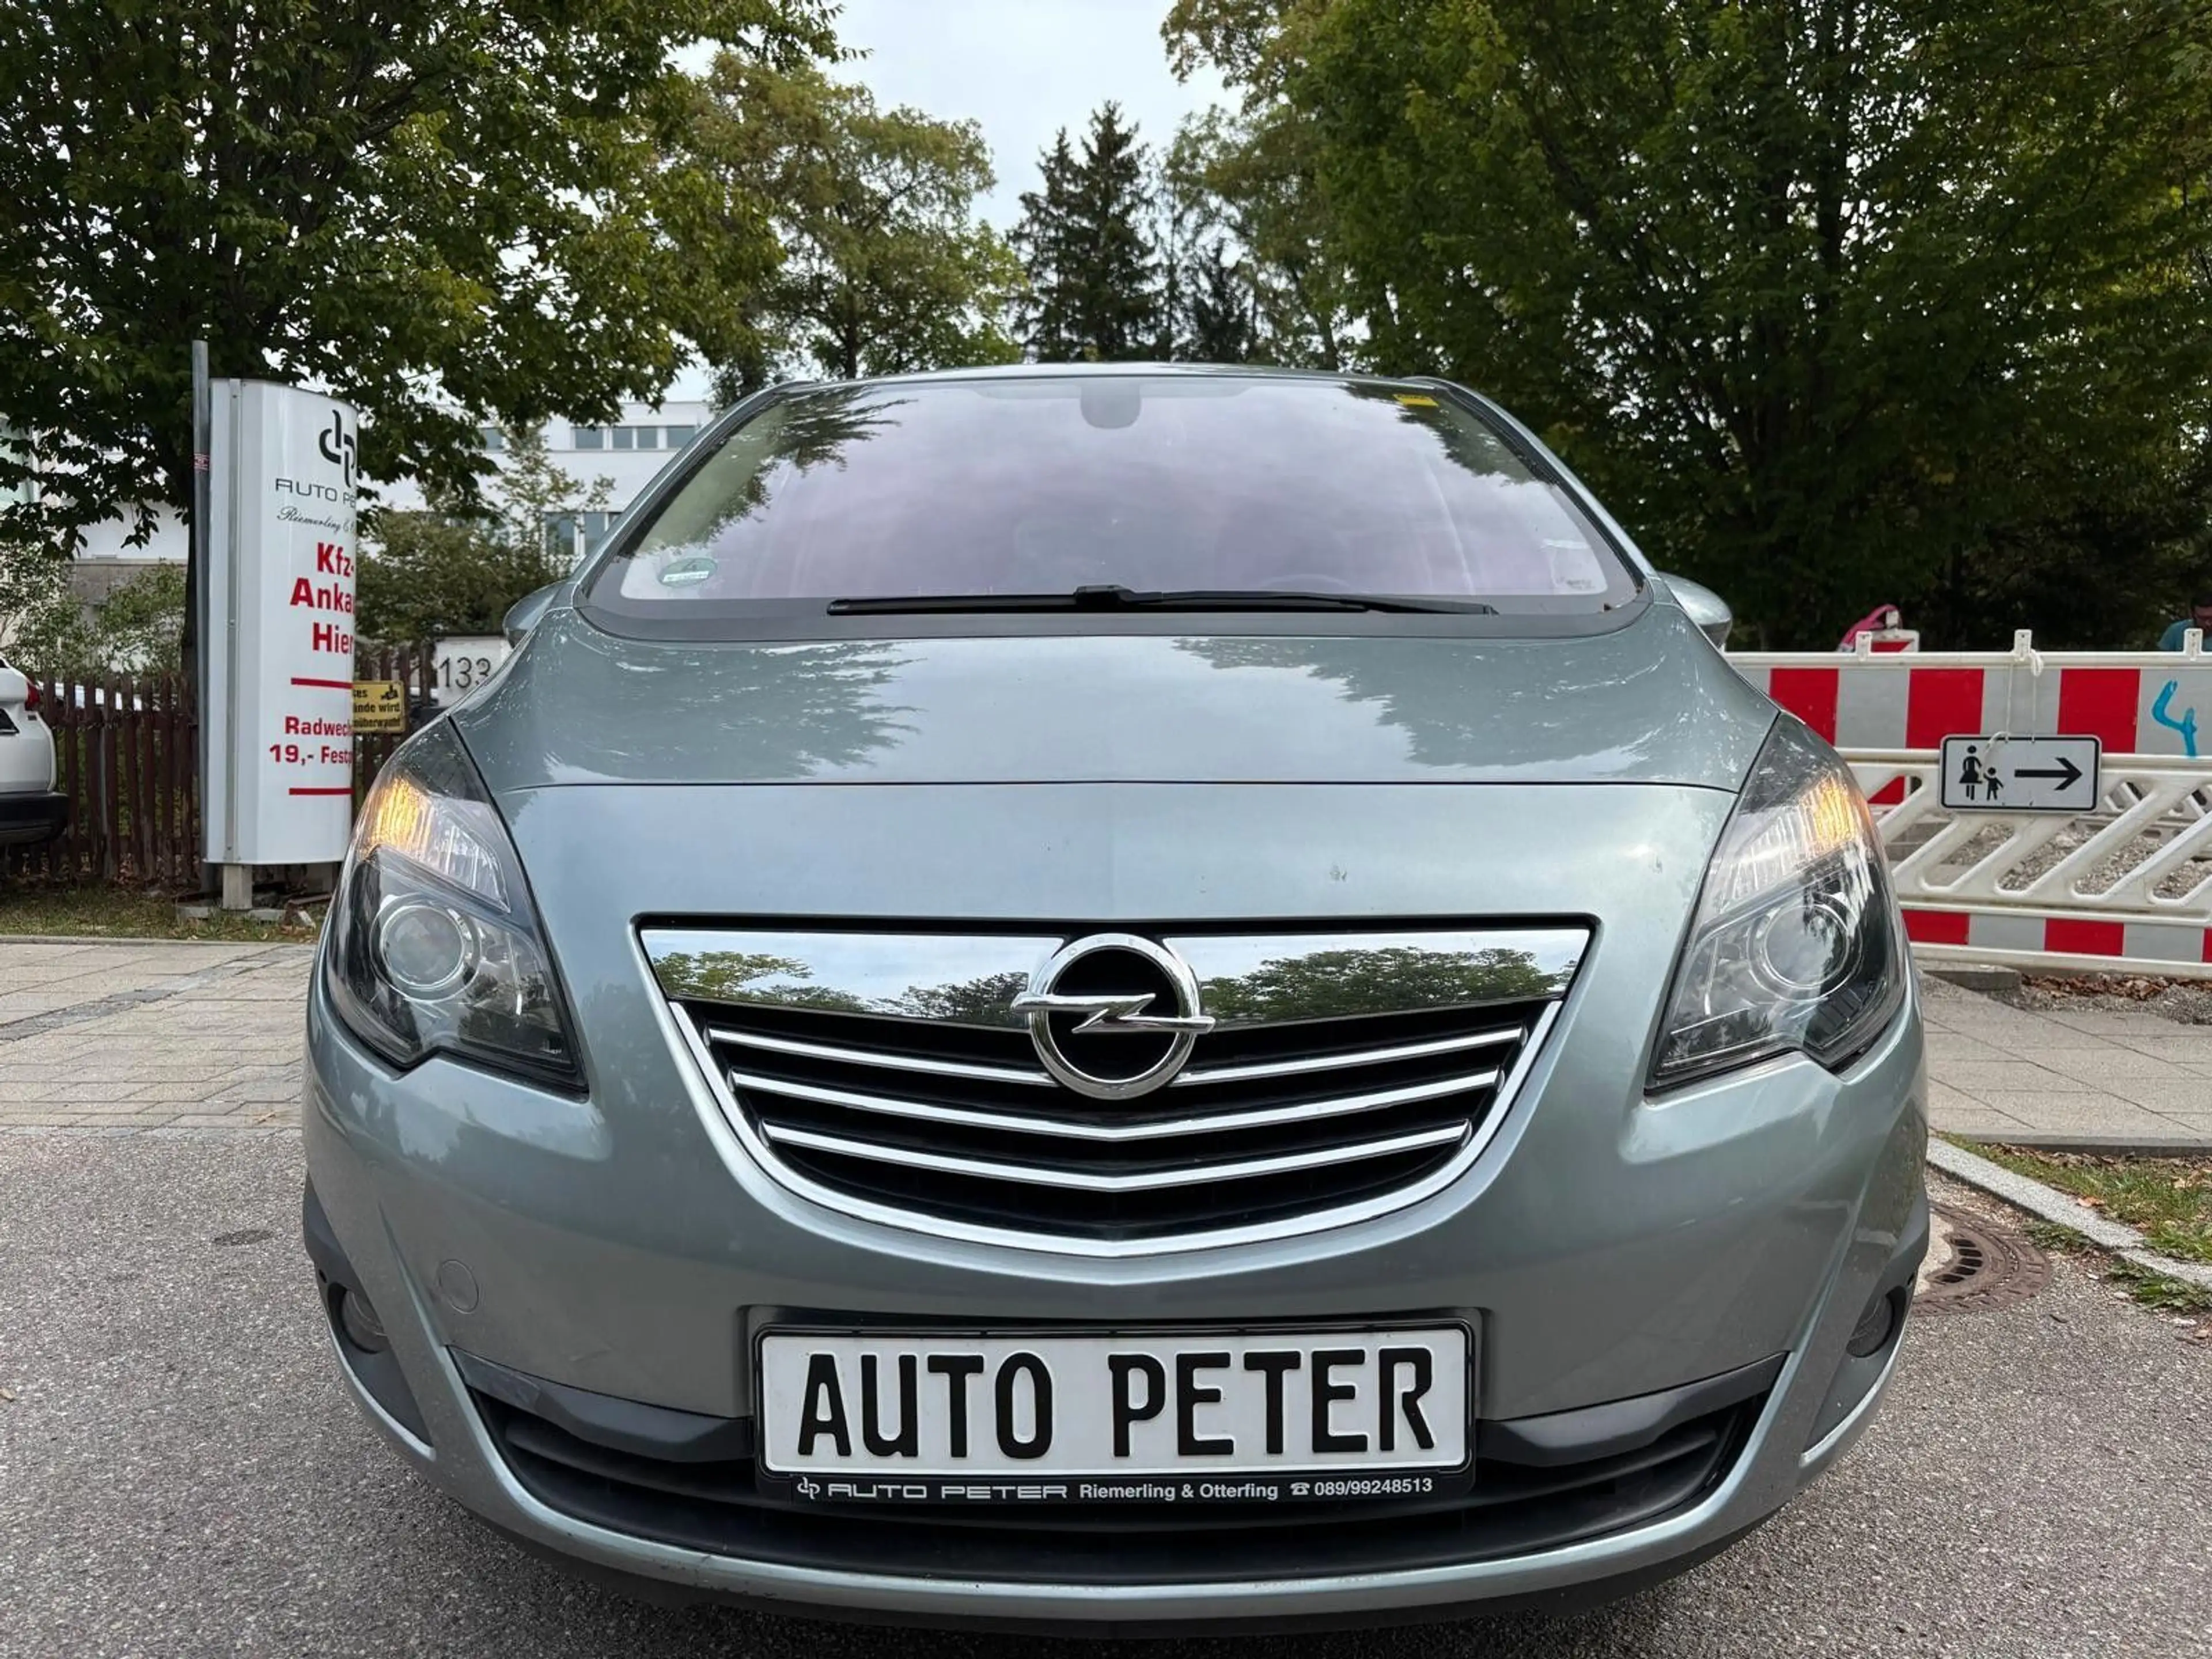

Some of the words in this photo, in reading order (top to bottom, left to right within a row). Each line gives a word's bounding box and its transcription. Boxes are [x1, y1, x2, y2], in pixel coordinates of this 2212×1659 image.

[276, 478, 338, 502] AUTO
[276, 505, 341, 533] Riemerling
[440, 657, 491, 688] 133
[2152, 680, 2198, 757] 4
[798, 1352, 1054, 1459] AUTO
[1108, 1348, 1434, 1457] PETER
[828, 1484, 927, 1498] AUTO
[941, 1486, 1068, 1499] PETER
[1080, 1484, 1176, 1501] Riemerling
[1181, 1485, 1194, 1498] &
[1199, 1483, 1278, 1501] Otterfing
[1315, 1478, 1433, 1496] 089/99248513
